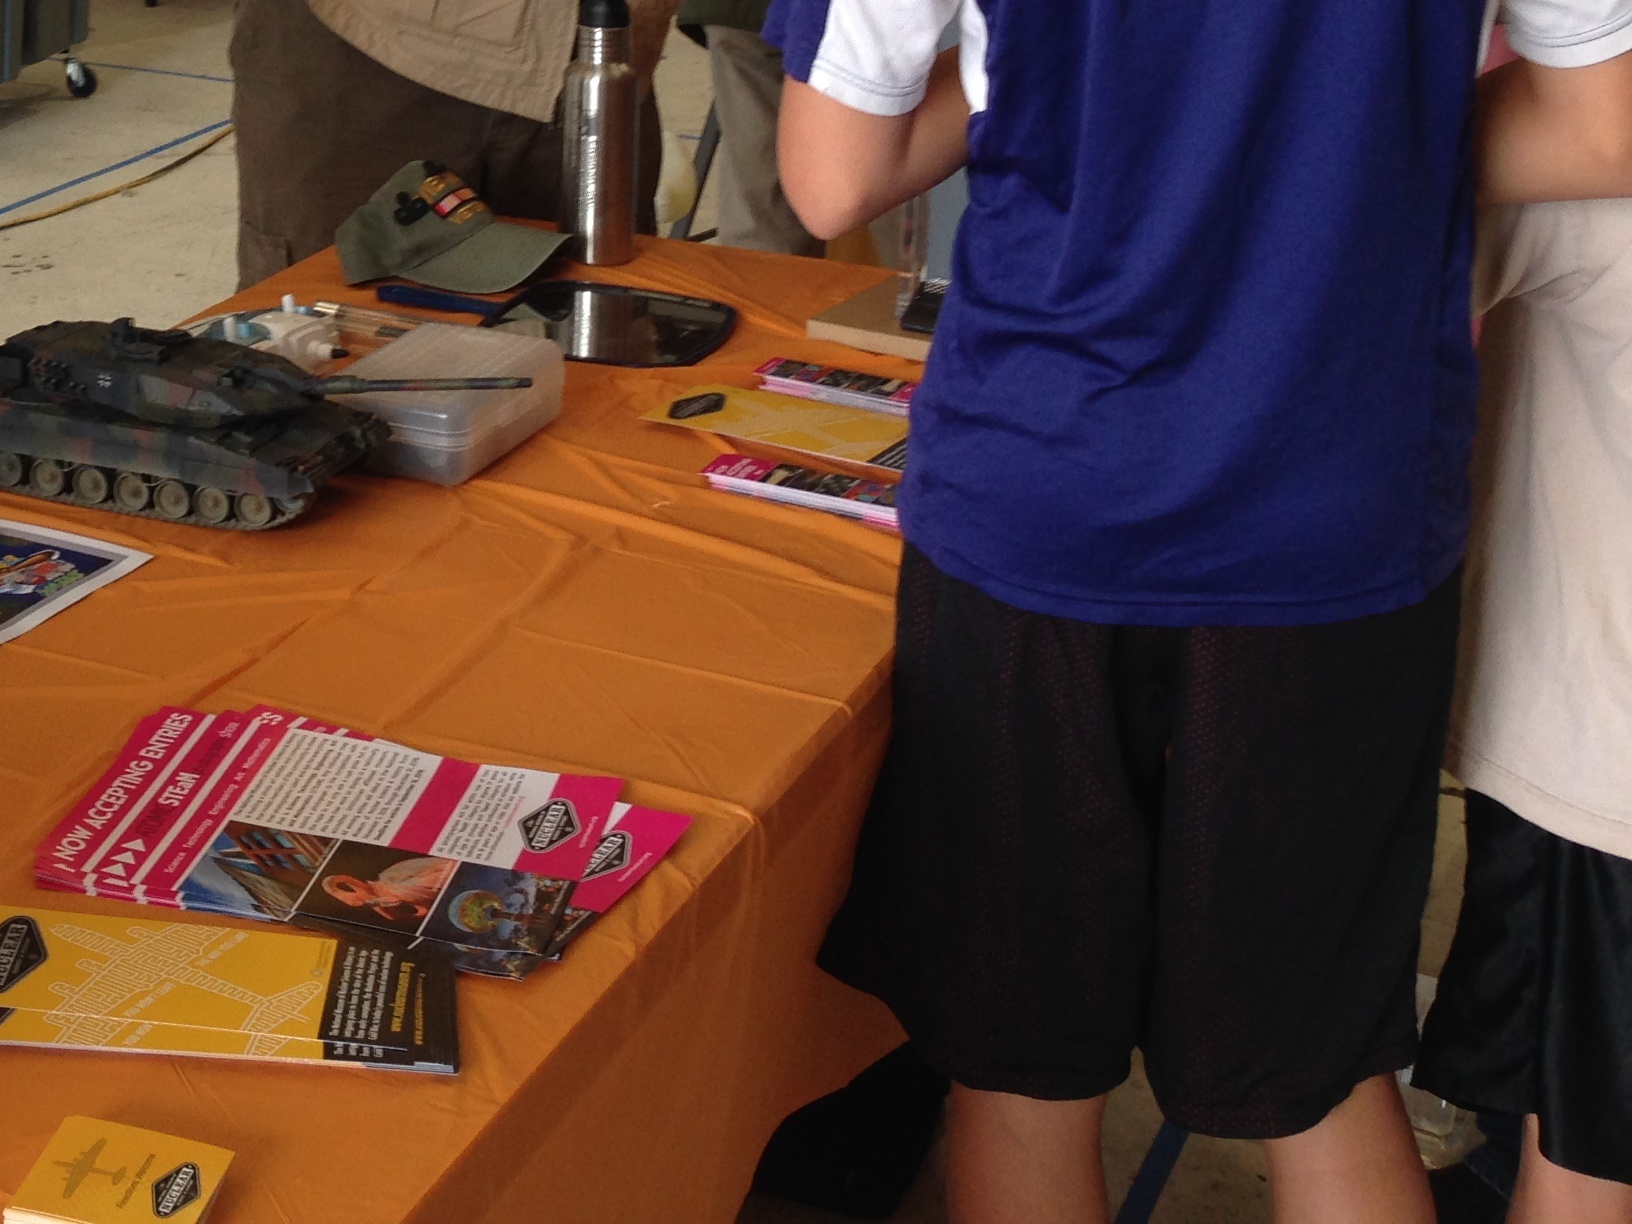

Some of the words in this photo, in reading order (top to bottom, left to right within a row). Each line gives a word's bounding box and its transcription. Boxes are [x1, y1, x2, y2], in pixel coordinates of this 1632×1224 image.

[52, 825, 93, 862] NOW
[84, 760, 154, 830] ACCEPTING
[139, 712, 193, 759] ENTRIES
[534, 803, 566, 848] NUCLEAR
[159, 1167, 194, 1214] NUCLEAR
